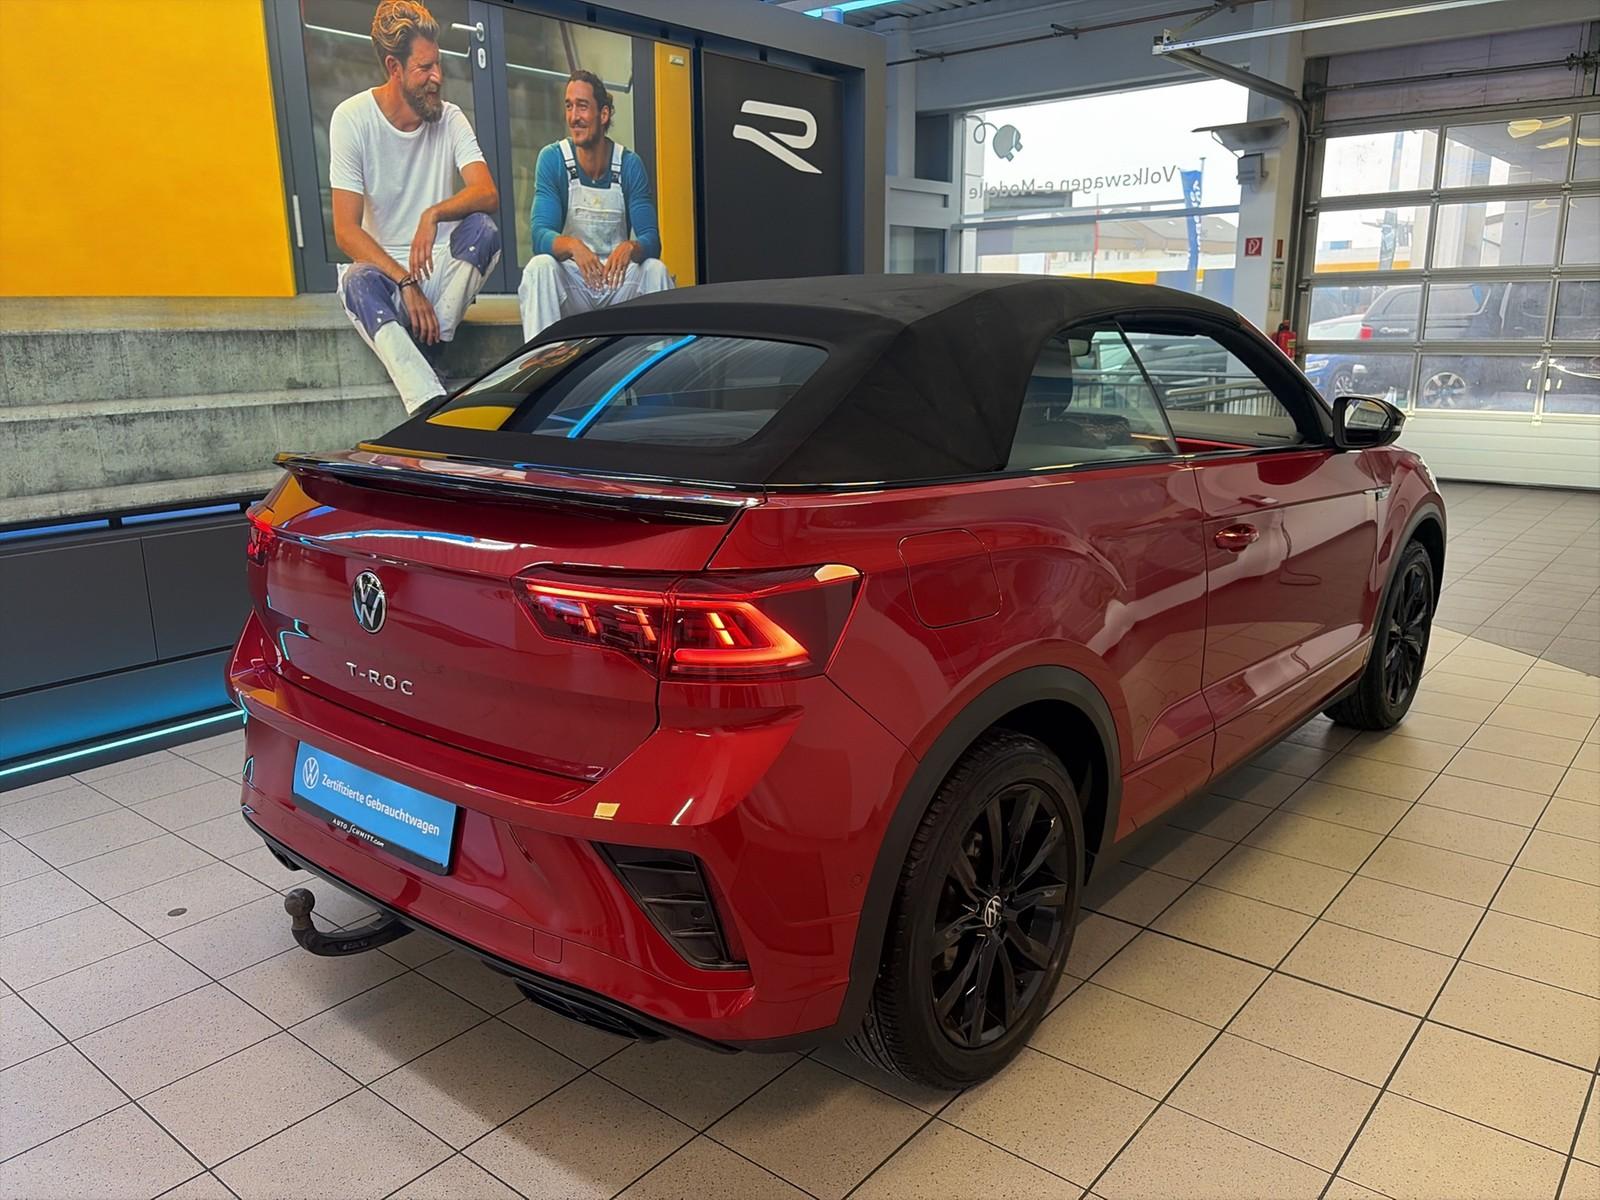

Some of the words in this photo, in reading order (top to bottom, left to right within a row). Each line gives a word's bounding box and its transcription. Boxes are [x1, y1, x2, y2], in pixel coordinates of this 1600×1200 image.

[346, 661, 413, 695] T-ROC
[322, 774, 365, 804] Zertifizierte
[365, 795, 440, 836] Gebrauchtwagen
[332, 818, 348, 830] AUTO
